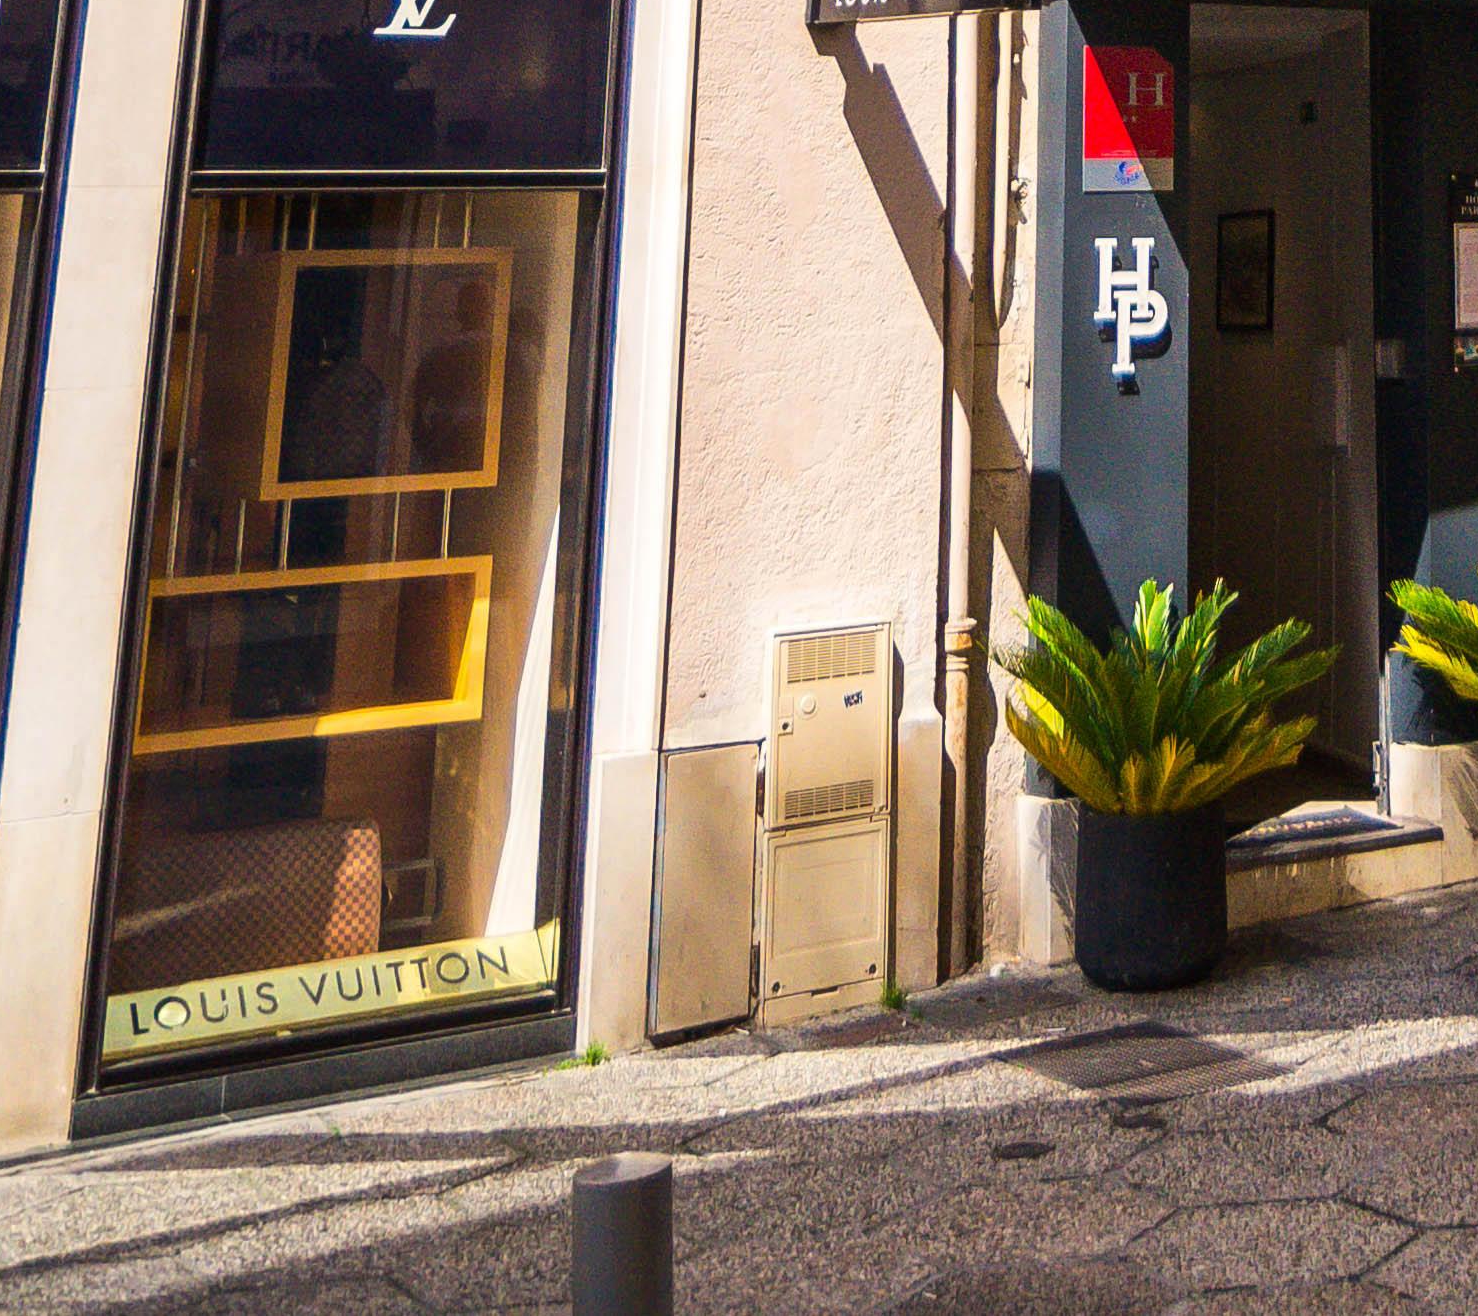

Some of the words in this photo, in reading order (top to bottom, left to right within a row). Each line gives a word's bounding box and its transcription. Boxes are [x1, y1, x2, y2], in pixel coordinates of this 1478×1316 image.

[1125, 71, 1167, 107] H
[128, 980, 279, 1037] LOUIS
[297, 944, 511, 1006] VUITTON
